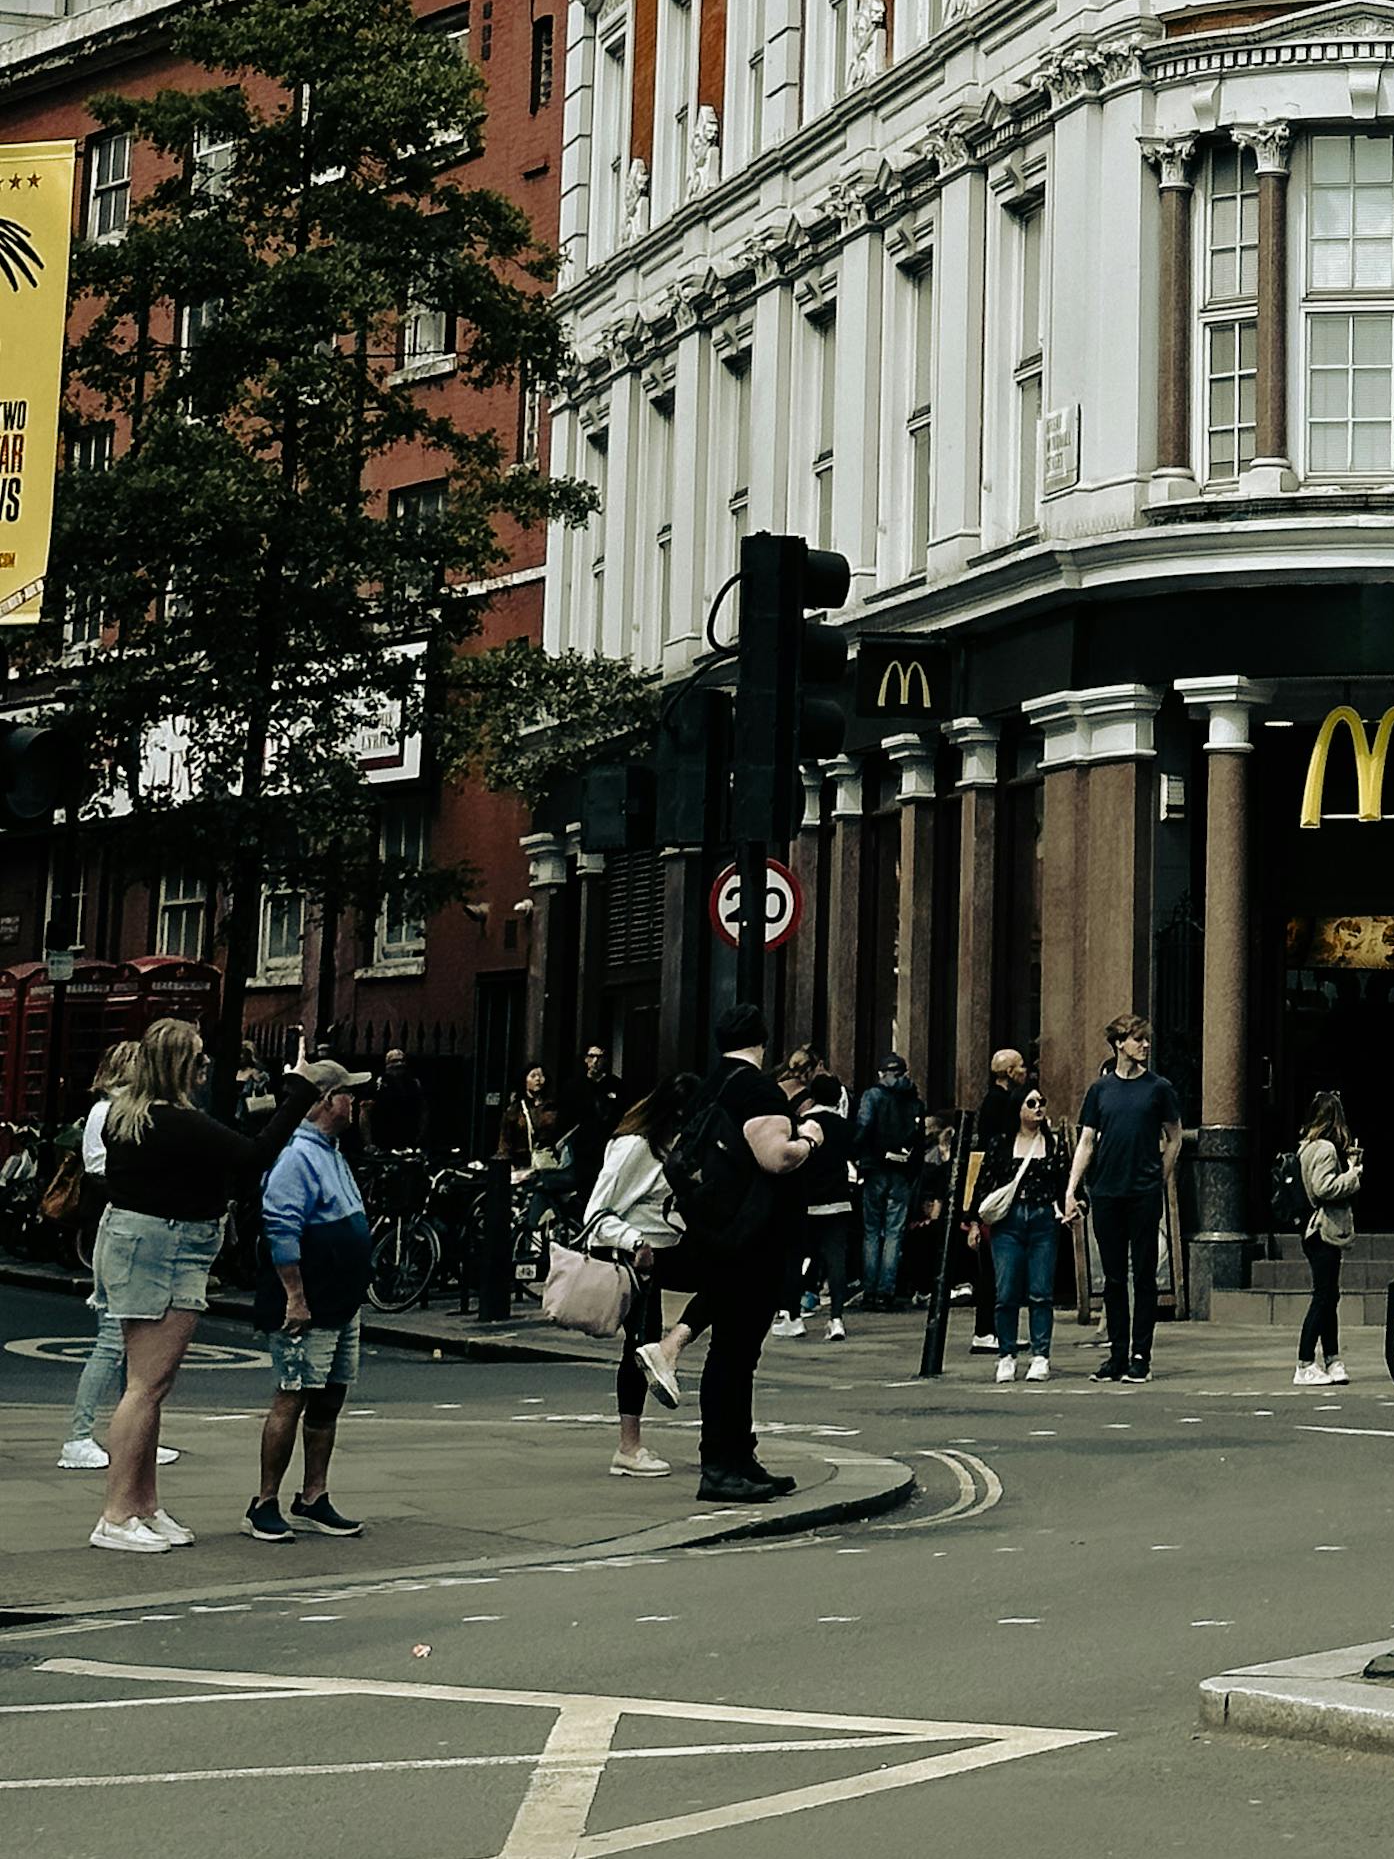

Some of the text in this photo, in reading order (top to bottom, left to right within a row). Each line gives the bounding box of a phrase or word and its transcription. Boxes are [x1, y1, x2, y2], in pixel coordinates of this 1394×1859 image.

[0, 401, 27, 431] WO
[0, 434, 24, 473] AR
[725, 887, 788, 924] 20
